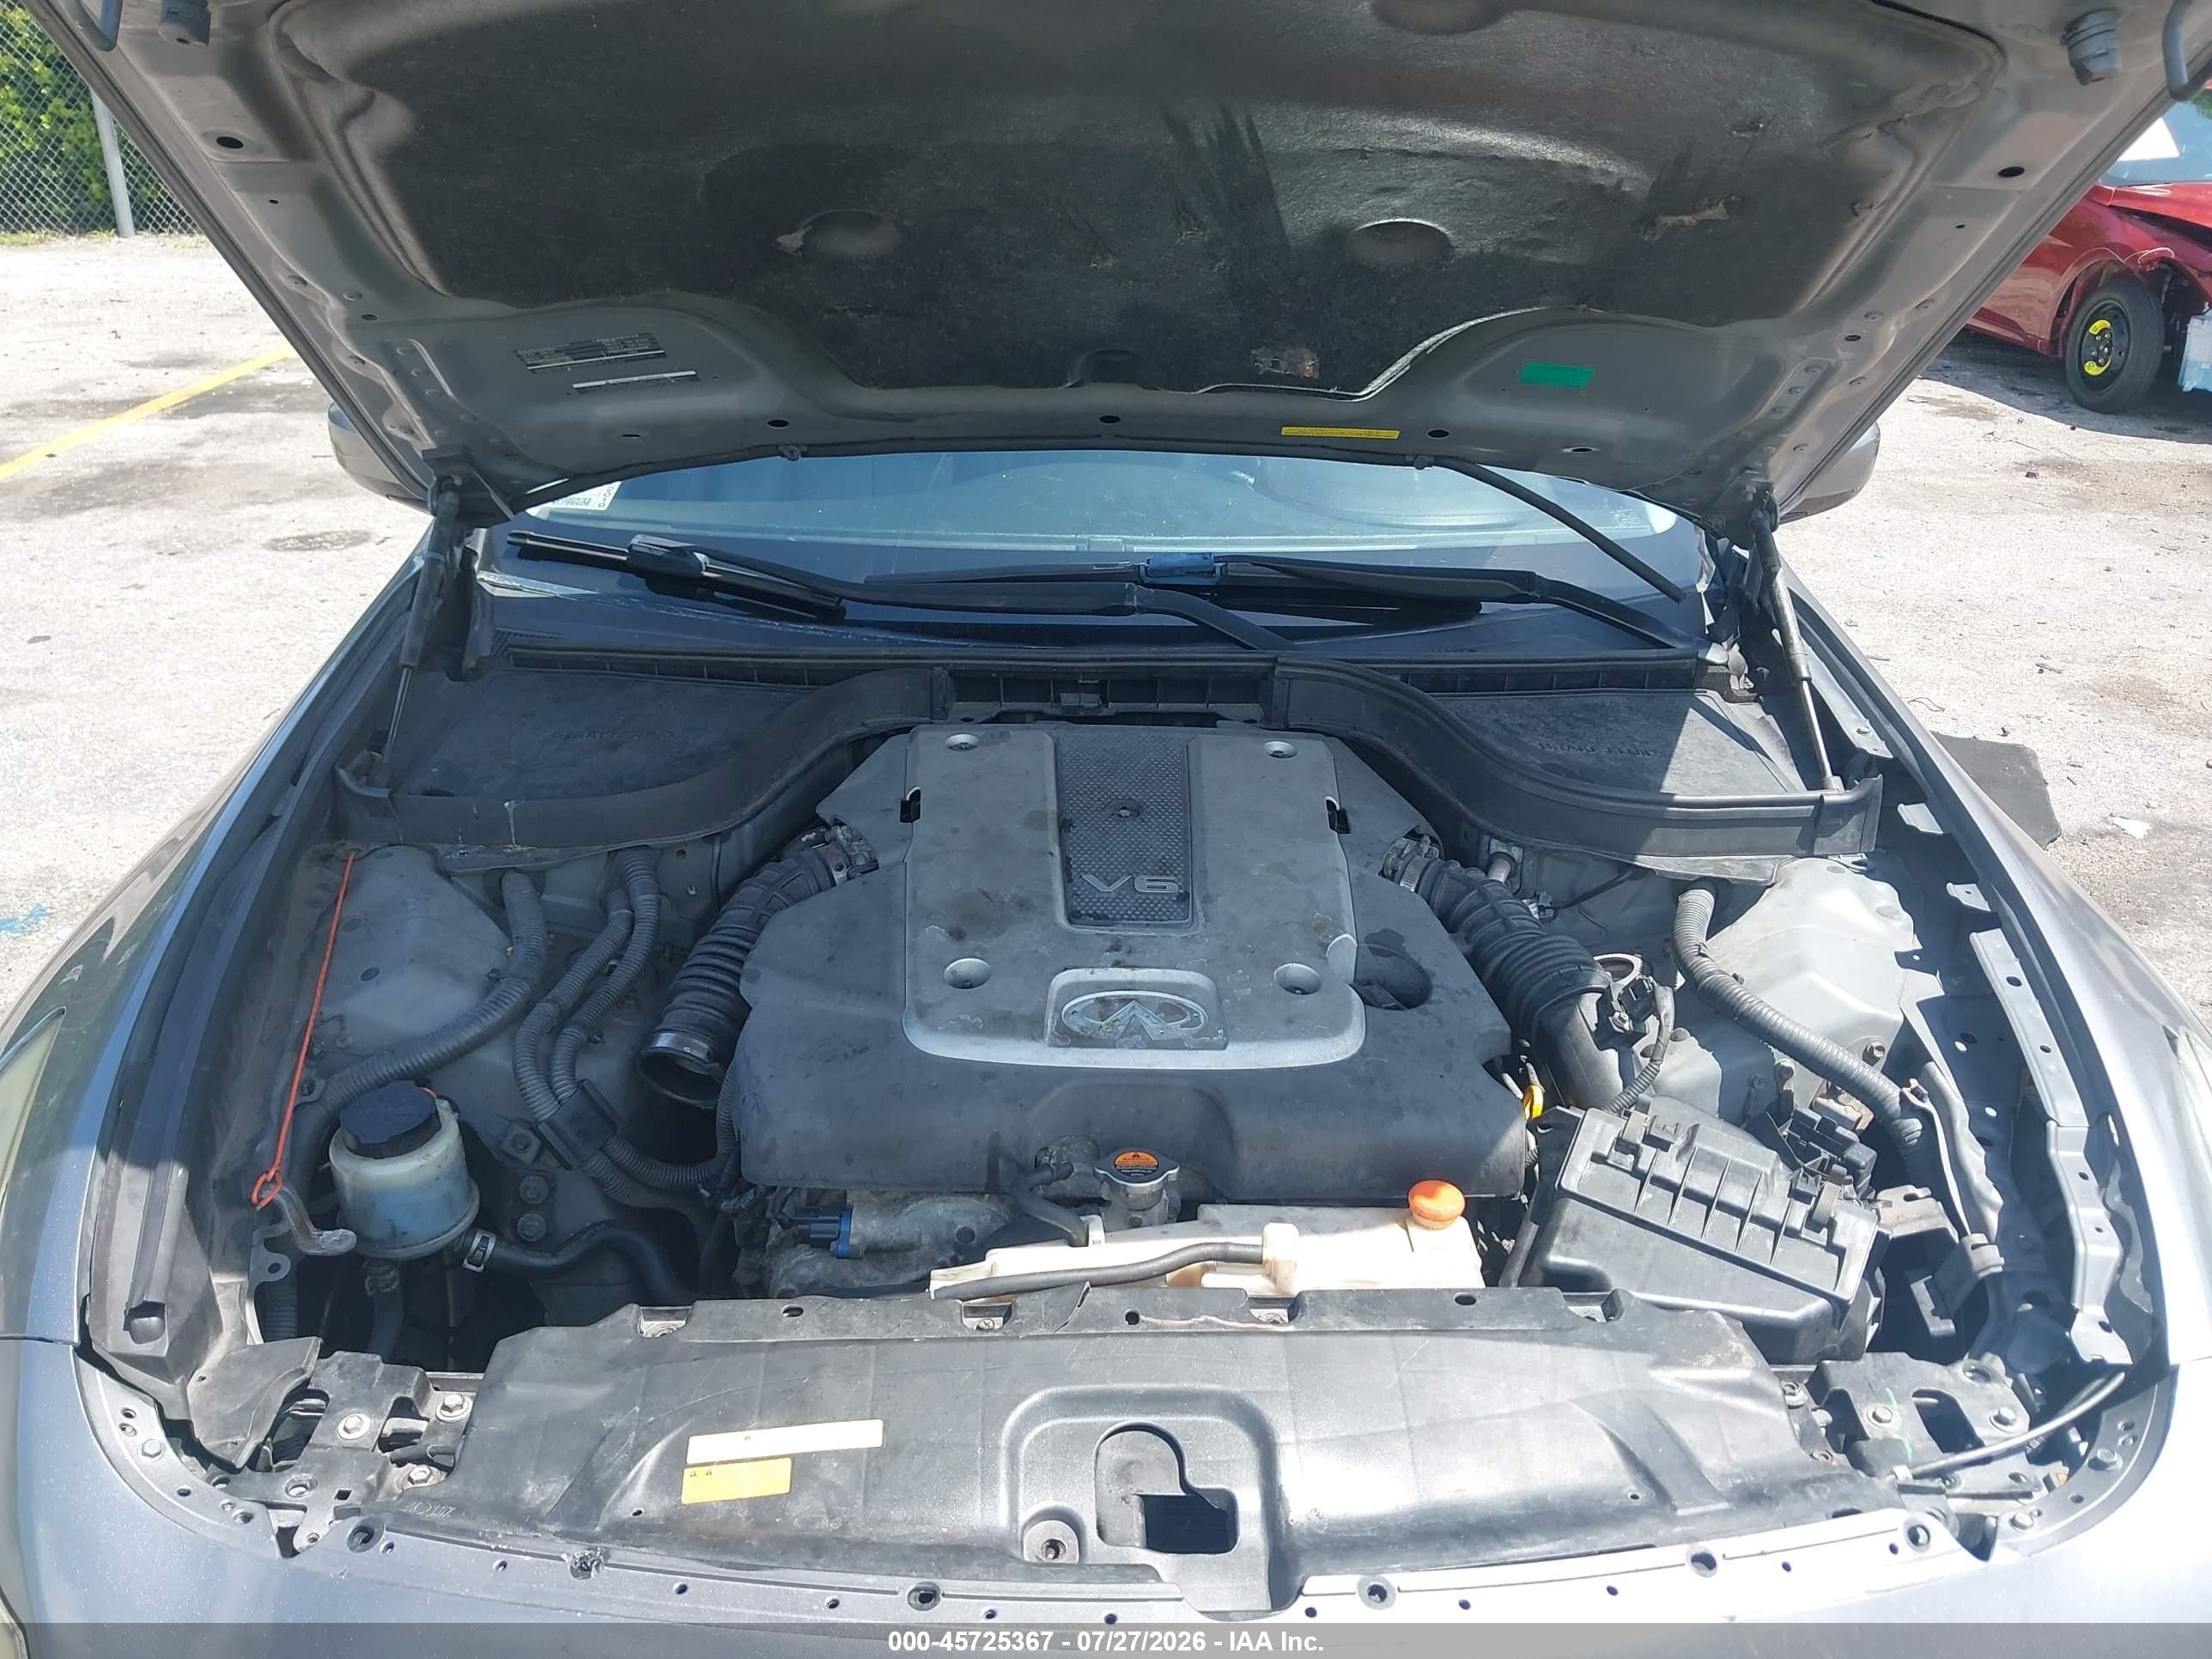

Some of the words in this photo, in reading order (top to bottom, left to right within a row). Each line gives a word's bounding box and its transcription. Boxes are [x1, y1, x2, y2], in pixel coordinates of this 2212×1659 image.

[1538, 742, 1601, 753] BRAKE
[1607, 747, 1657, 757] FLUID
[1081, 874, 1179, 893] V6
